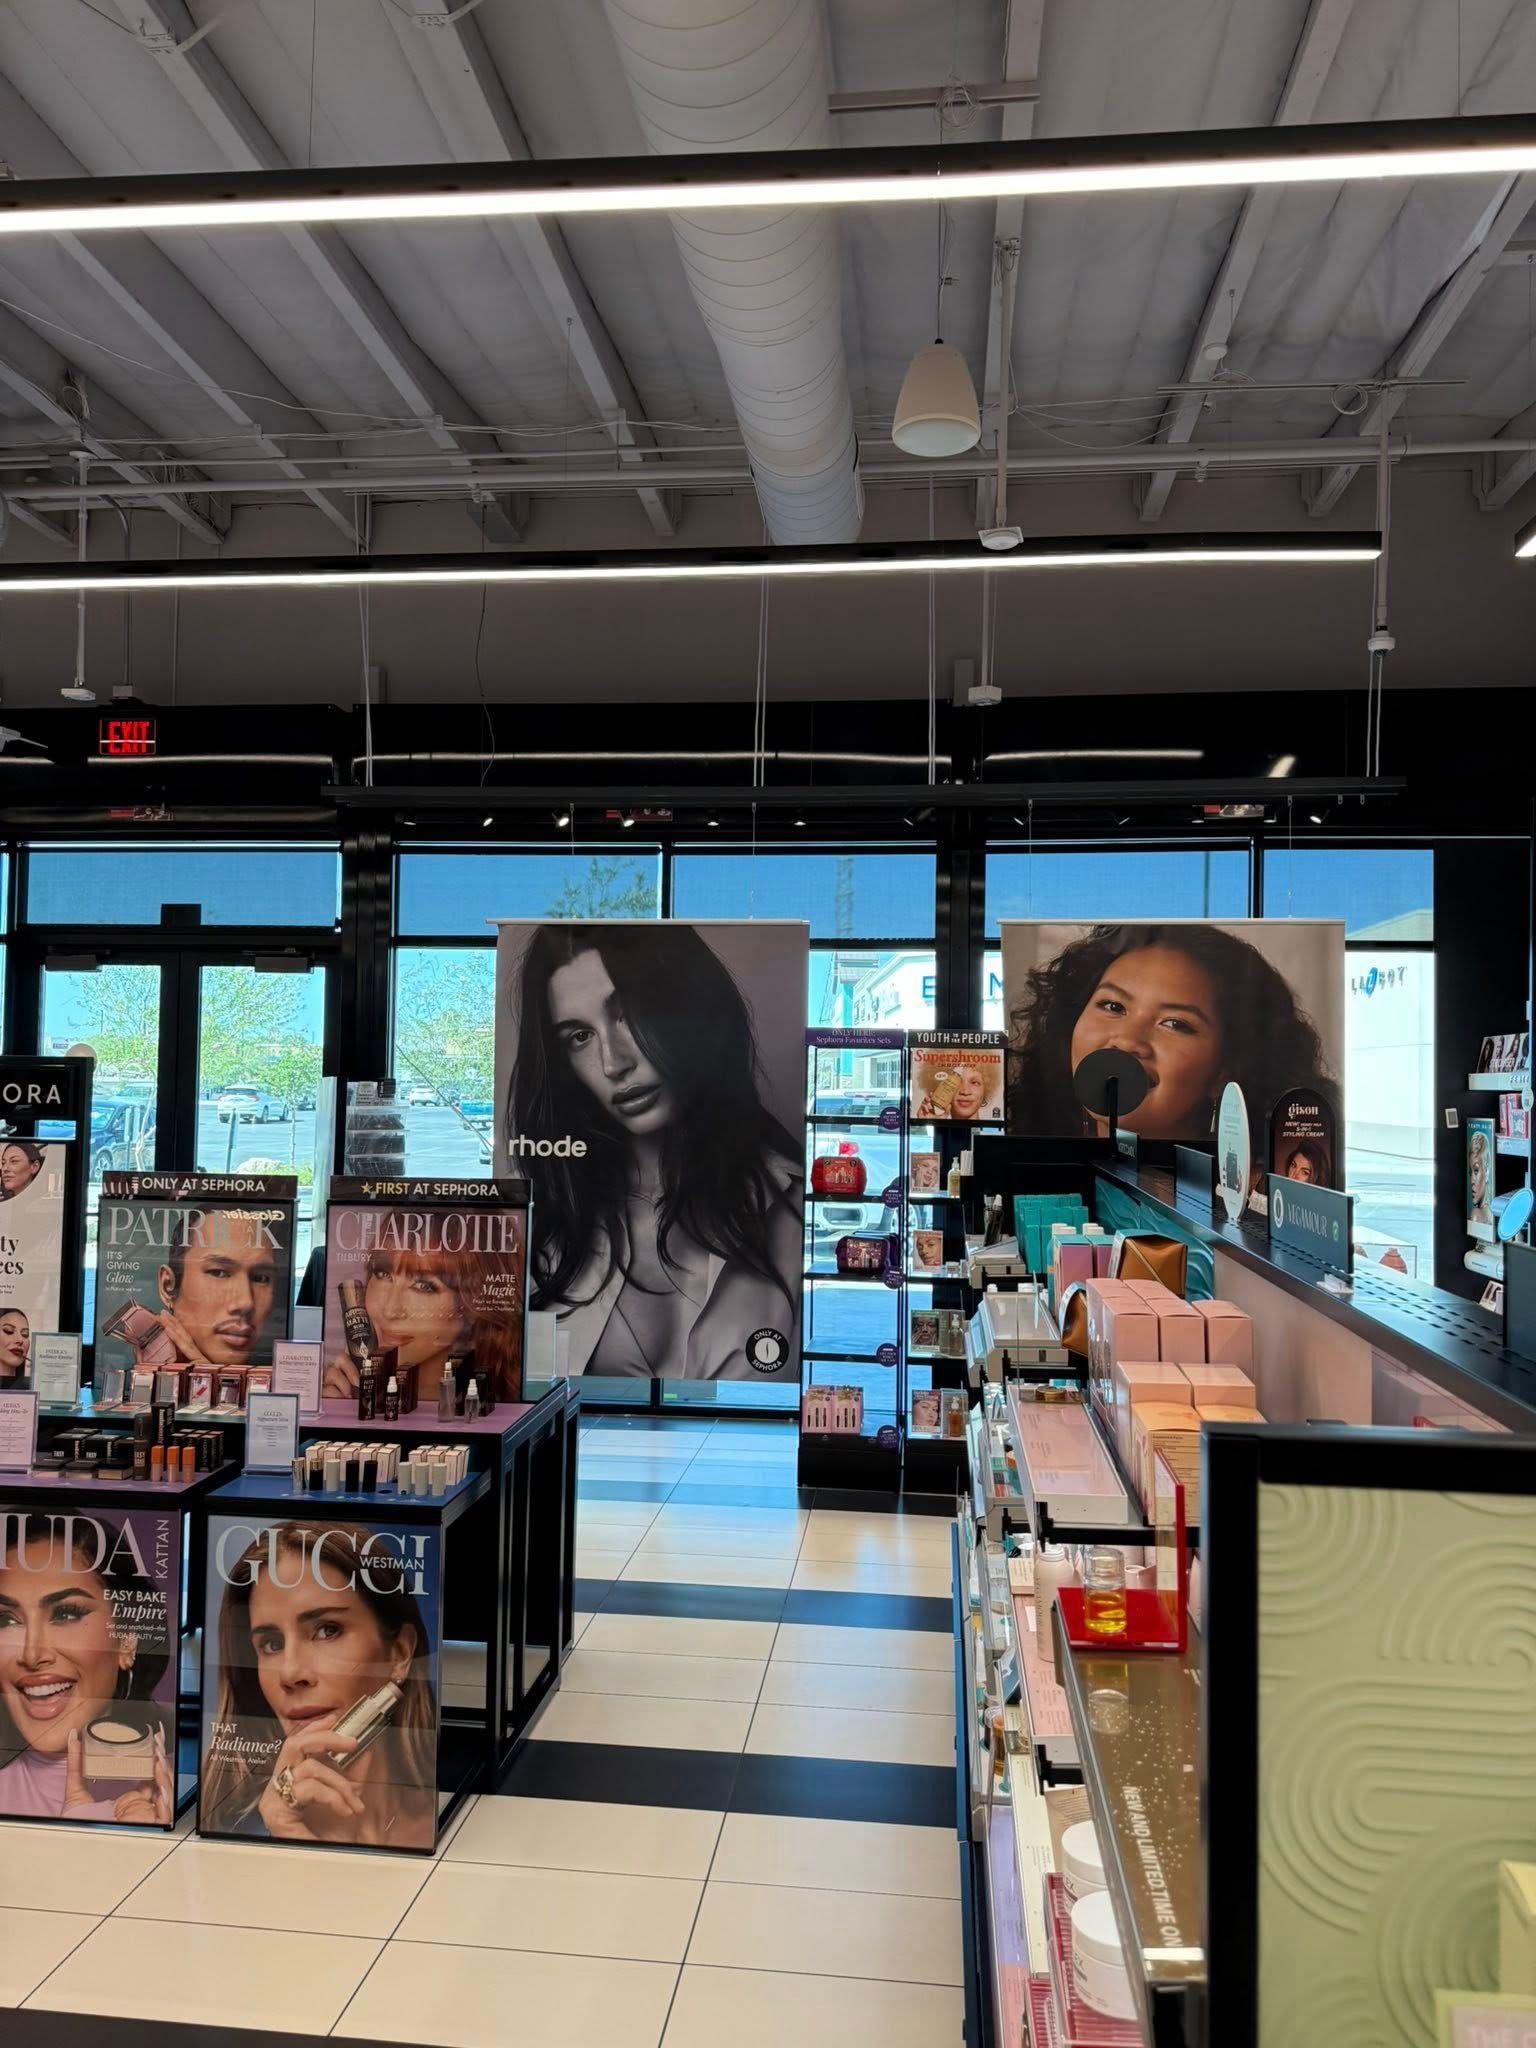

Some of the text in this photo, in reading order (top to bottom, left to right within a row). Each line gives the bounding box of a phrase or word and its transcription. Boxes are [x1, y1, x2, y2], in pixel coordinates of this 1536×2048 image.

[107, 721, 149, 753] EXIT
[917, 1032, 950, 1043] YOUTH
[962, 1033, 1000, 1044] PEOPLE
[914, 1049, 1001, 1064] Supershroom
[508, 1134, 588, 1158] rhode
[142, 1176, 266, 1193] ONLY AT SEPHORA
[375, 1182, 500, 1197] FIRST AT SEPHORA
[335, 1210, 519, 1257] CHARLOTTE
[107, 1250, 123, 1260] IT'S
[336, 1252, 373, 1263] TILBURY
[106, 1261, 141, 1271] GIVING
[106, 1271, 135, 1284] Glow
[485, 1273, 516, 1283] MATTE
[480, 1284, 516, 1298] Magic
[753, 1330, 772, 1340] ONLY
[752, 1359, 783, 1371] SEPHORA
[155, 1519, 169, 1579] KATTAN
[215, 1525, 430, 1595] GUCCI
[360, 1556, 424, 1570] WESTMAN
[103, 1589, 167, 1603] EASY BAKE
[111, 1602, 167, 1622] Empire
[211, 1722, 237, 1733] THAT
[210, 1736, 282, 1754] Radiance?
[1130, 1811, 1150, 1836] AND
[1137, 1839, 1165, 1888] LIMITED
[1151, 1889, 1177, 1923] TIME
